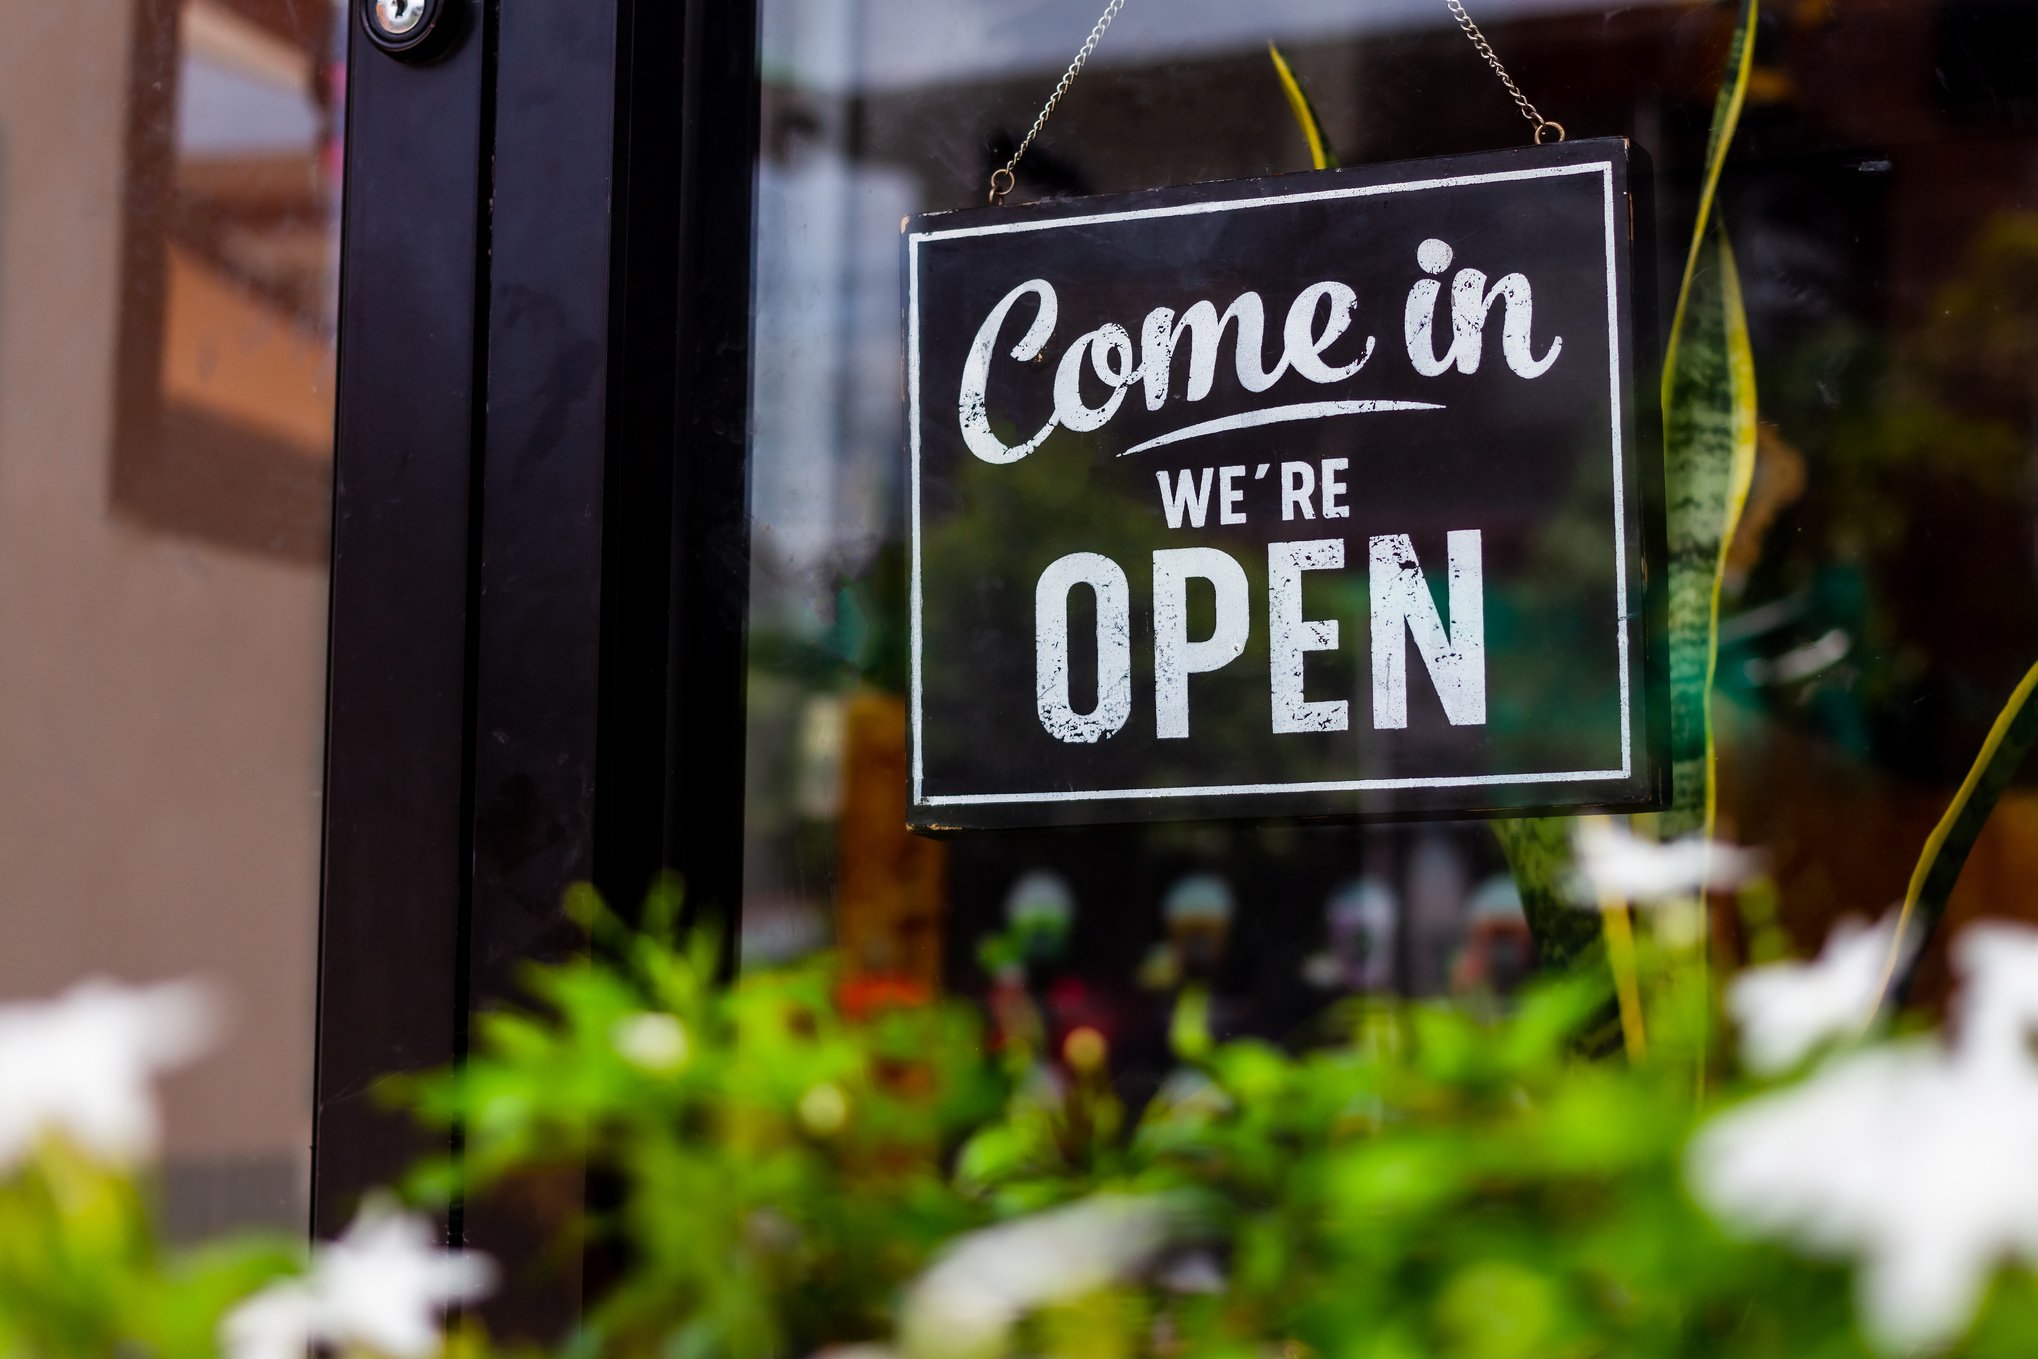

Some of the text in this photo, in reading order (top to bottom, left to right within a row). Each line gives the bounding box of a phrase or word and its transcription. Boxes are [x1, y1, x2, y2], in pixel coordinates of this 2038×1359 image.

[958, 238, 1563, 465] Come in
[1156, 457, 1350, 529] WE'RE
[1035, 529, 1487, 744] OPEN
